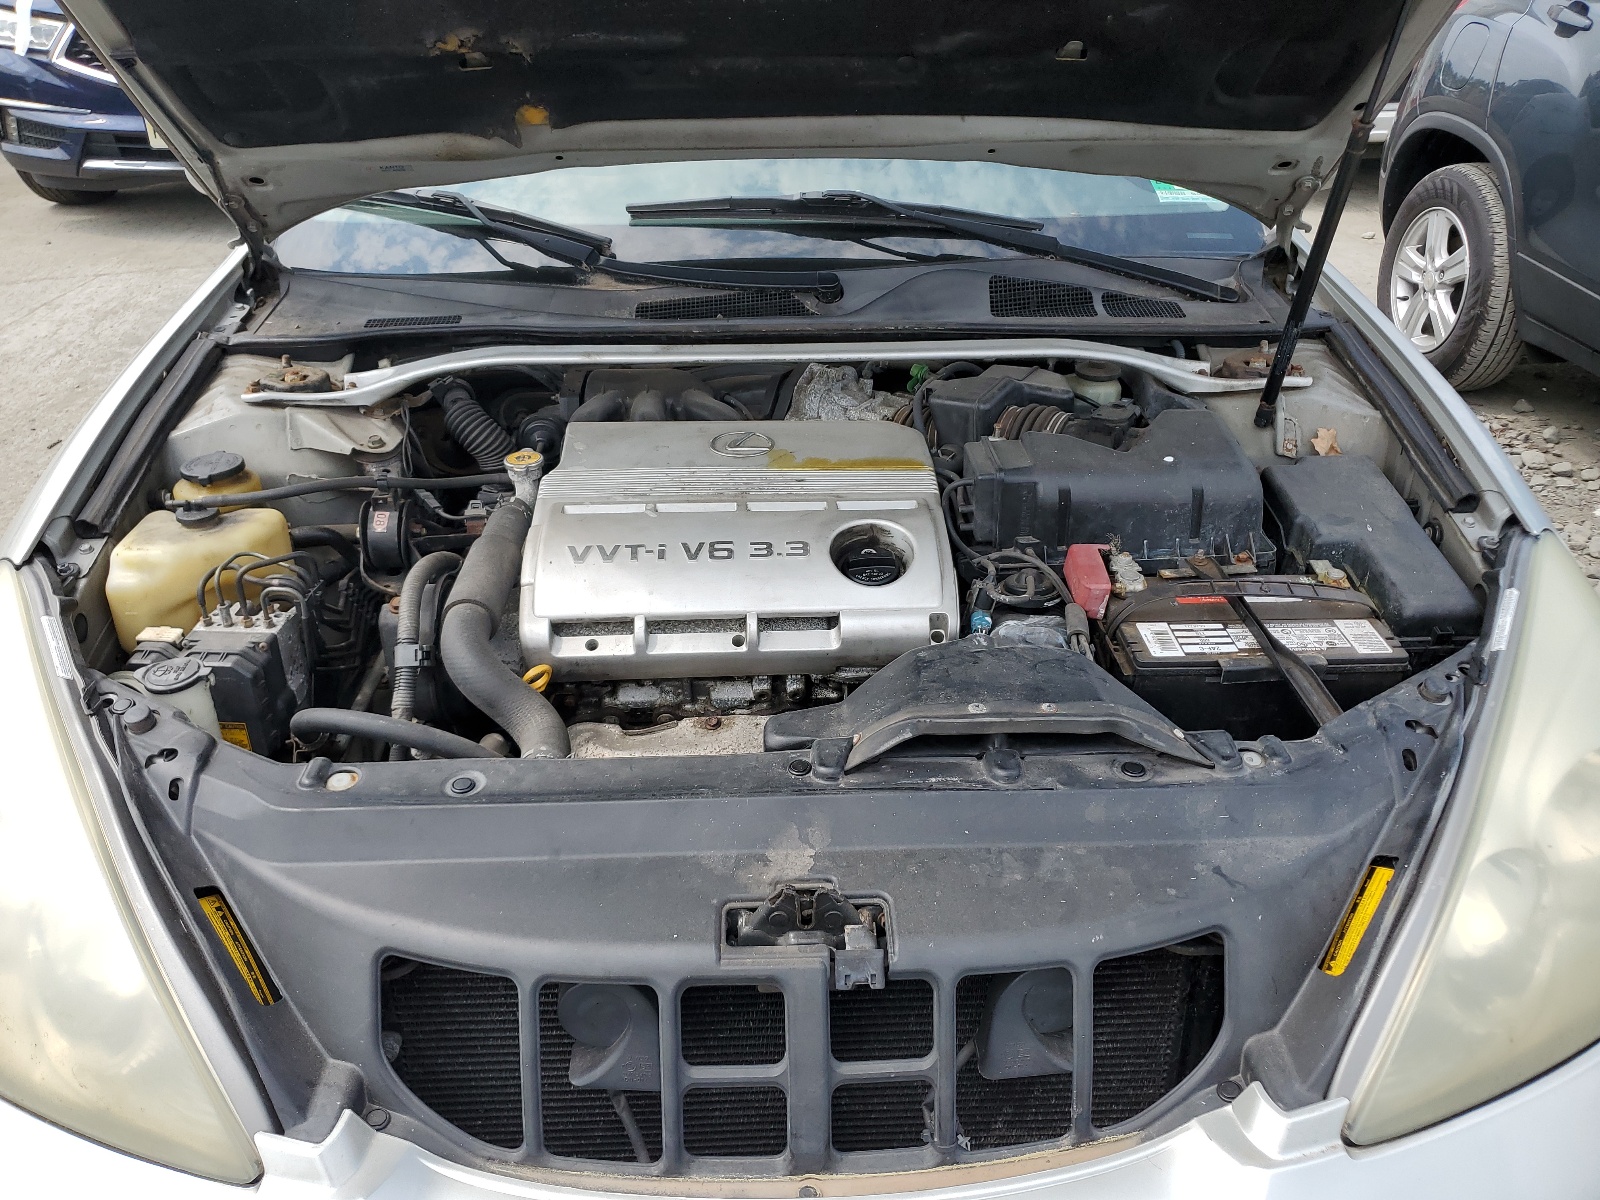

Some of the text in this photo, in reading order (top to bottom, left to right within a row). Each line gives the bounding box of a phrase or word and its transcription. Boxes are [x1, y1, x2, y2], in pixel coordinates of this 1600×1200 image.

[566, 540, 811, 564] VVT-i V6 3.3
